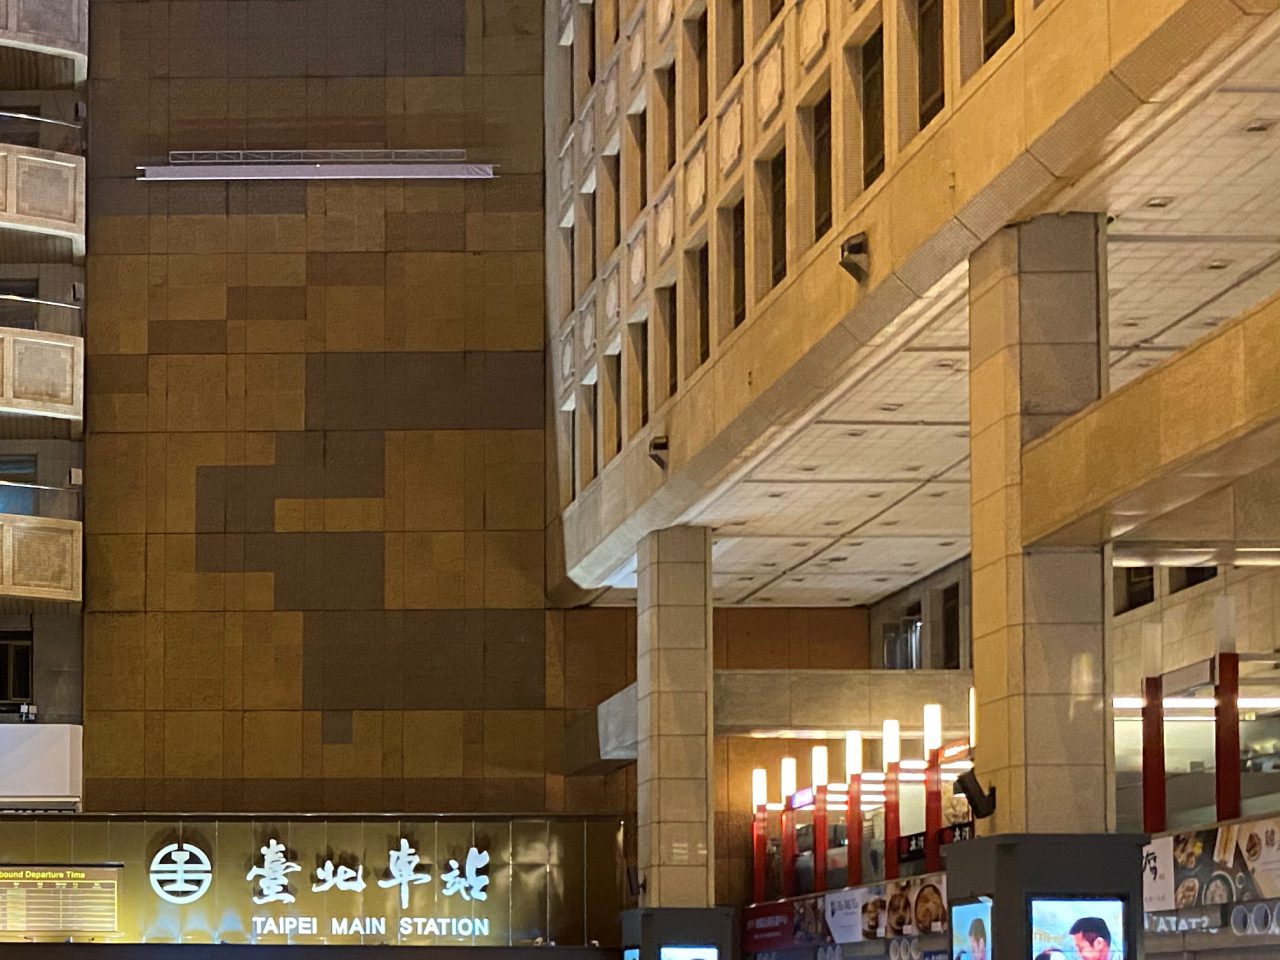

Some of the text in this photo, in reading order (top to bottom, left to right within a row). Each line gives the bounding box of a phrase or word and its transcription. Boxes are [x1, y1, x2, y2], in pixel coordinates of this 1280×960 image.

[25, 870, 64, 879] Departure
[65, 870, 86, 879] Time
[246, 838, 490, 910] 臺北車站
[252, 917, 490, 936] TAIPEI MAIN STATION
